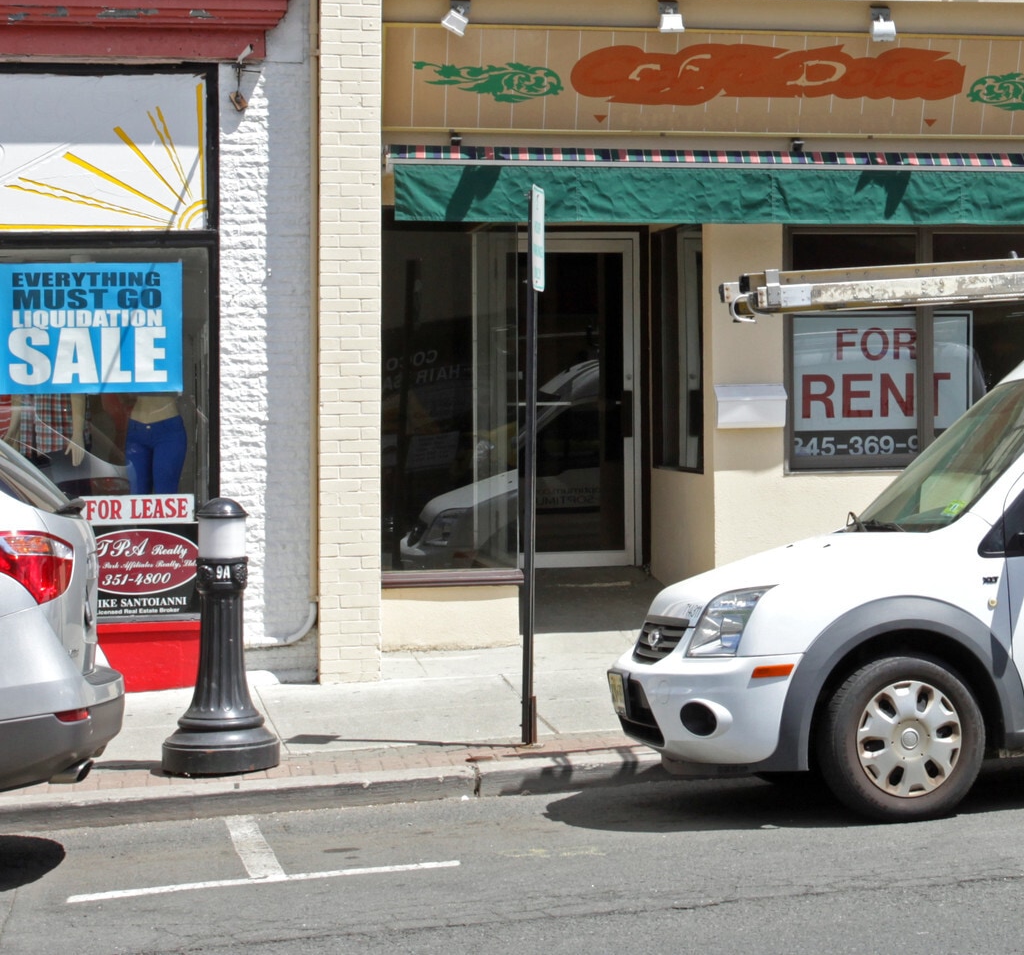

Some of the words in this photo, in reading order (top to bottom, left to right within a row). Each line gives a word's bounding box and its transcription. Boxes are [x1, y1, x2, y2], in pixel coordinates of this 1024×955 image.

[12, 271, 161, 288] EVERYTHING
[13, 289, 108, 309] MUST
[117, 289, 162, 309] GO
[12, 309, 163, 329] LIQUIDATION
[836, 327, 917, 361] FOR
[8, 327, 168, 386] SALE
[801, 373, 951, 419] RENT
[86, 499, 122, 521] FOR
[130, 498, 188, 519] LEASE
[151, 545, 187, 559] Realty
[102, 573, 171, 586] 351-4800
[216, 565, 230, 579] 9A
[97, 599, 117, 608] IKE
[121, 597, 187, 608] SANTOIANNI
